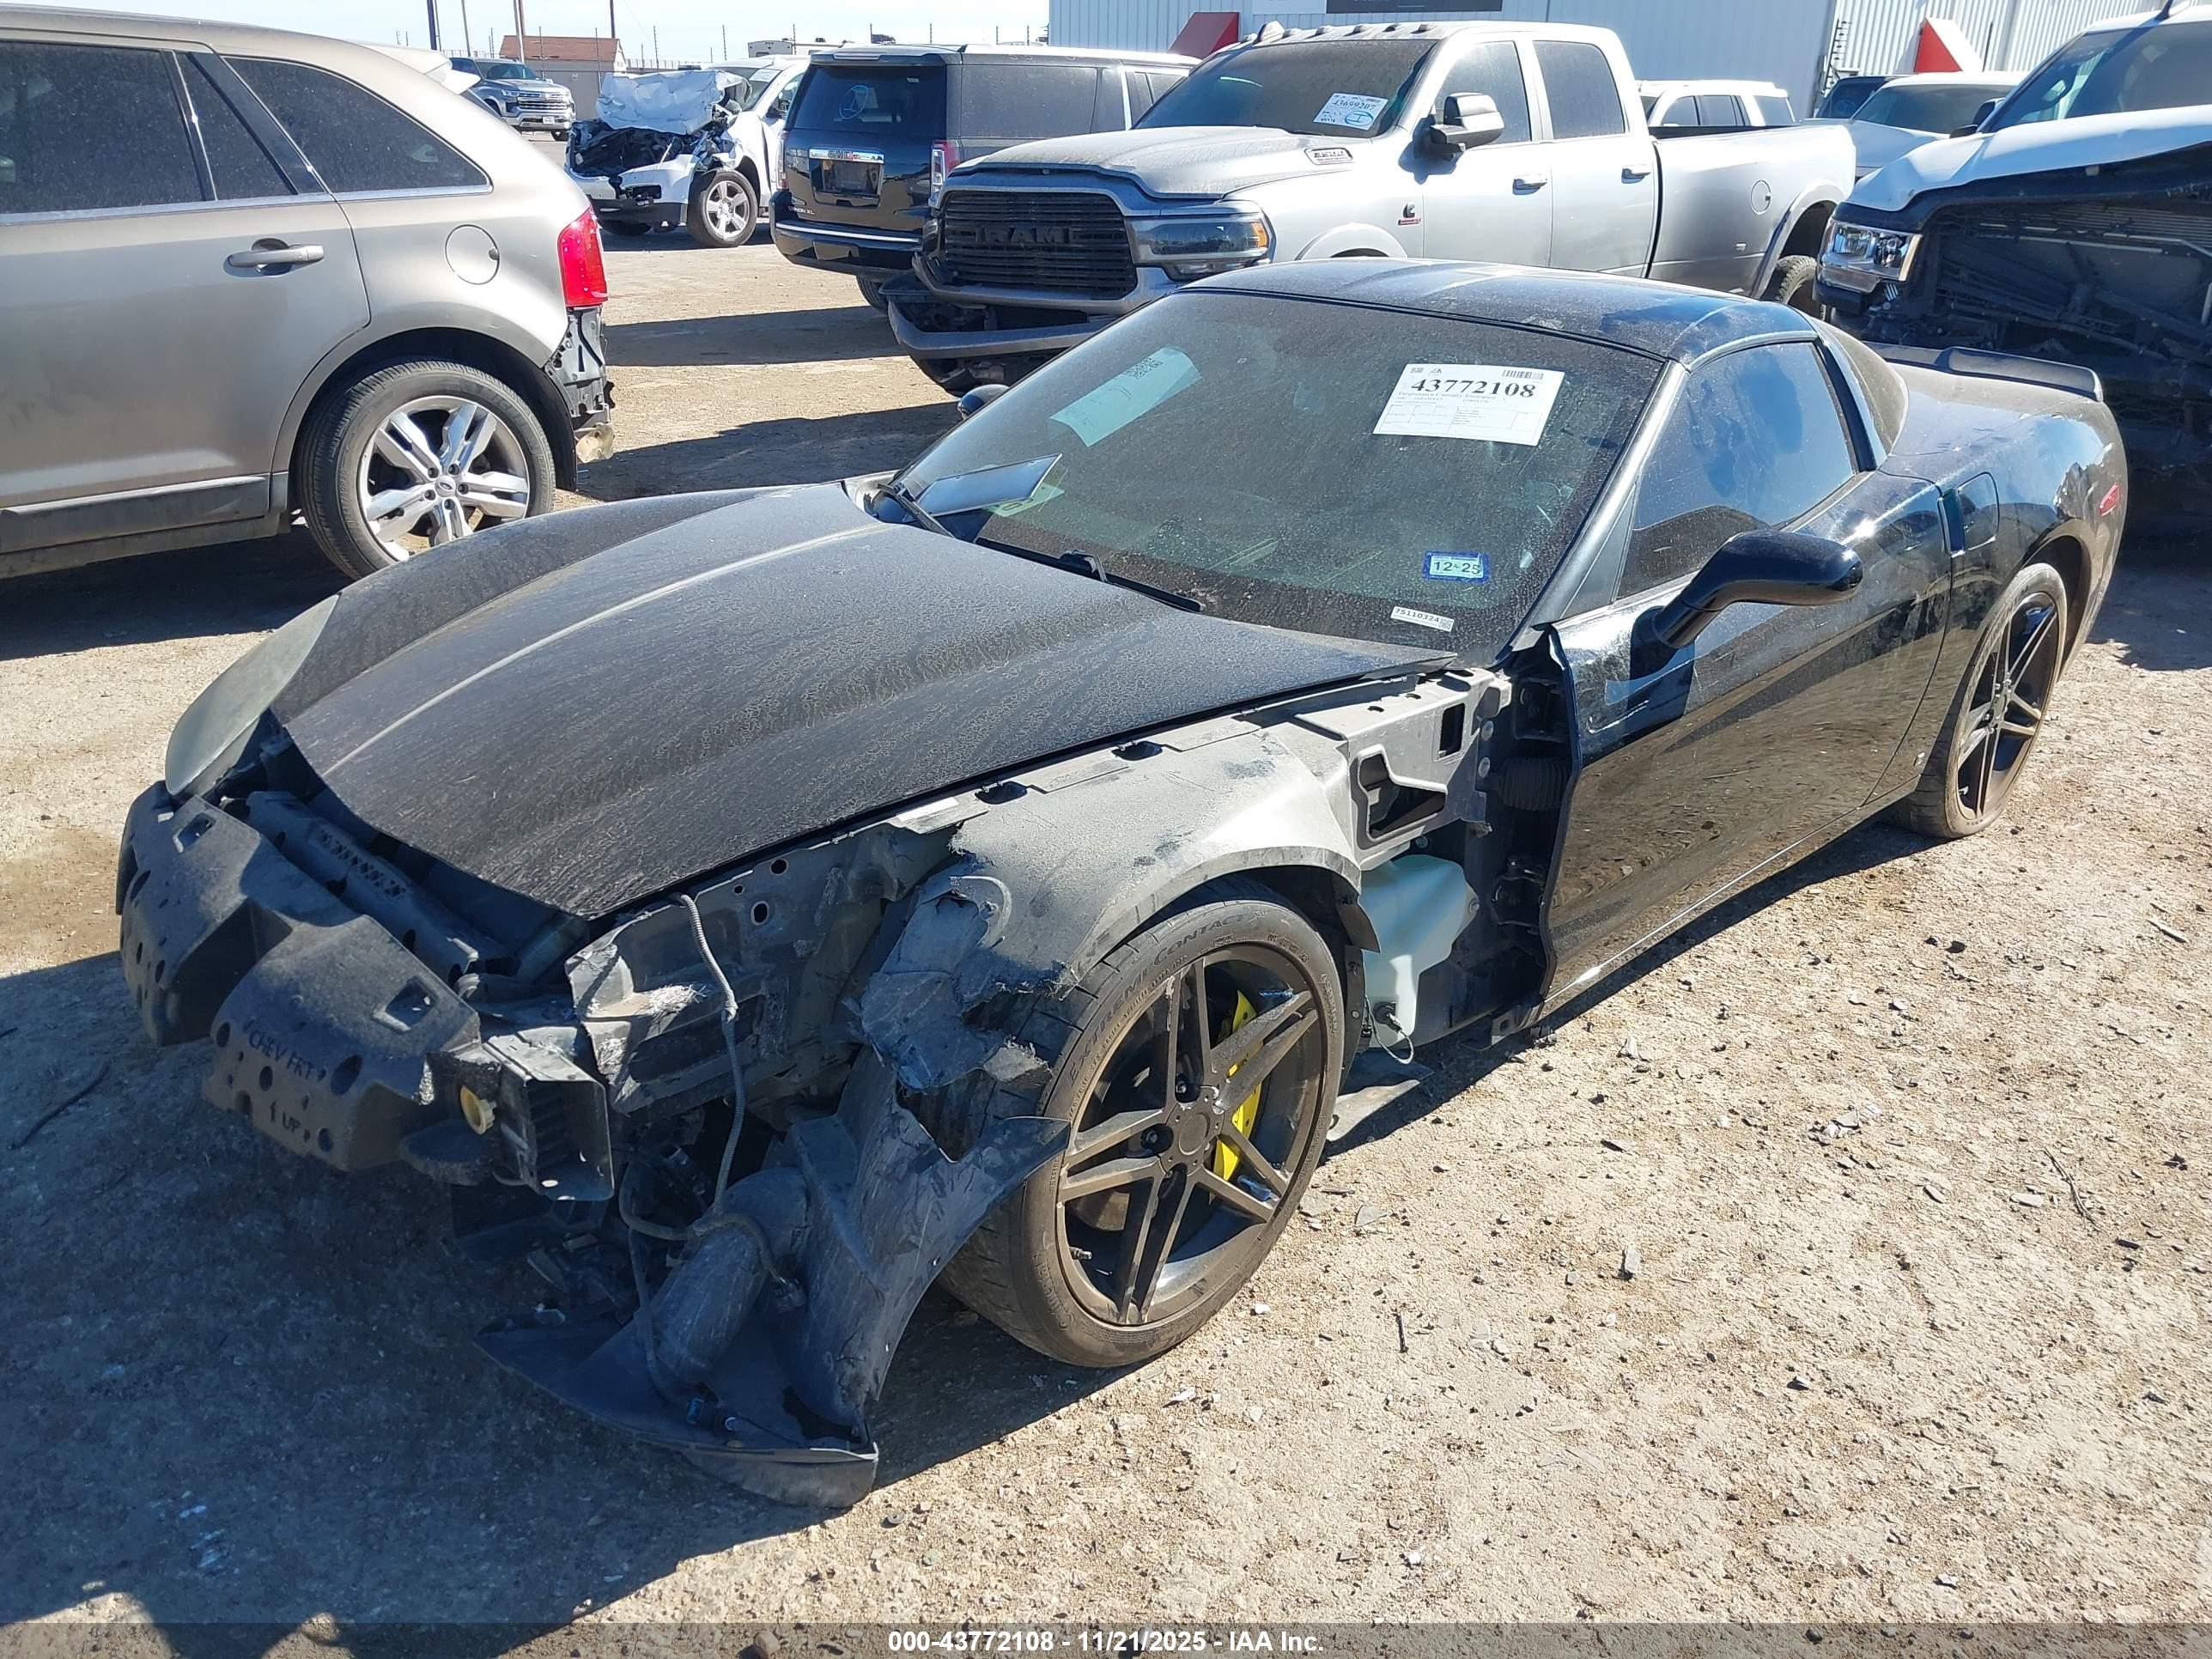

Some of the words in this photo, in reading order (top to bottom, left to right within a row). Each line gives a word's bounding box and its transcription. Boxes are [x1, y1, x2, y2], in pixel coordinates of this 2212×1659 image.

[828, 149, 853, 161] GMC
[985, 226, 1071, 244] RAM
[1411, 379, 1536, 398] 43772108
[1395, 608, 1440, 623] 75110324
[282, 1112, 302, 1133] UP
